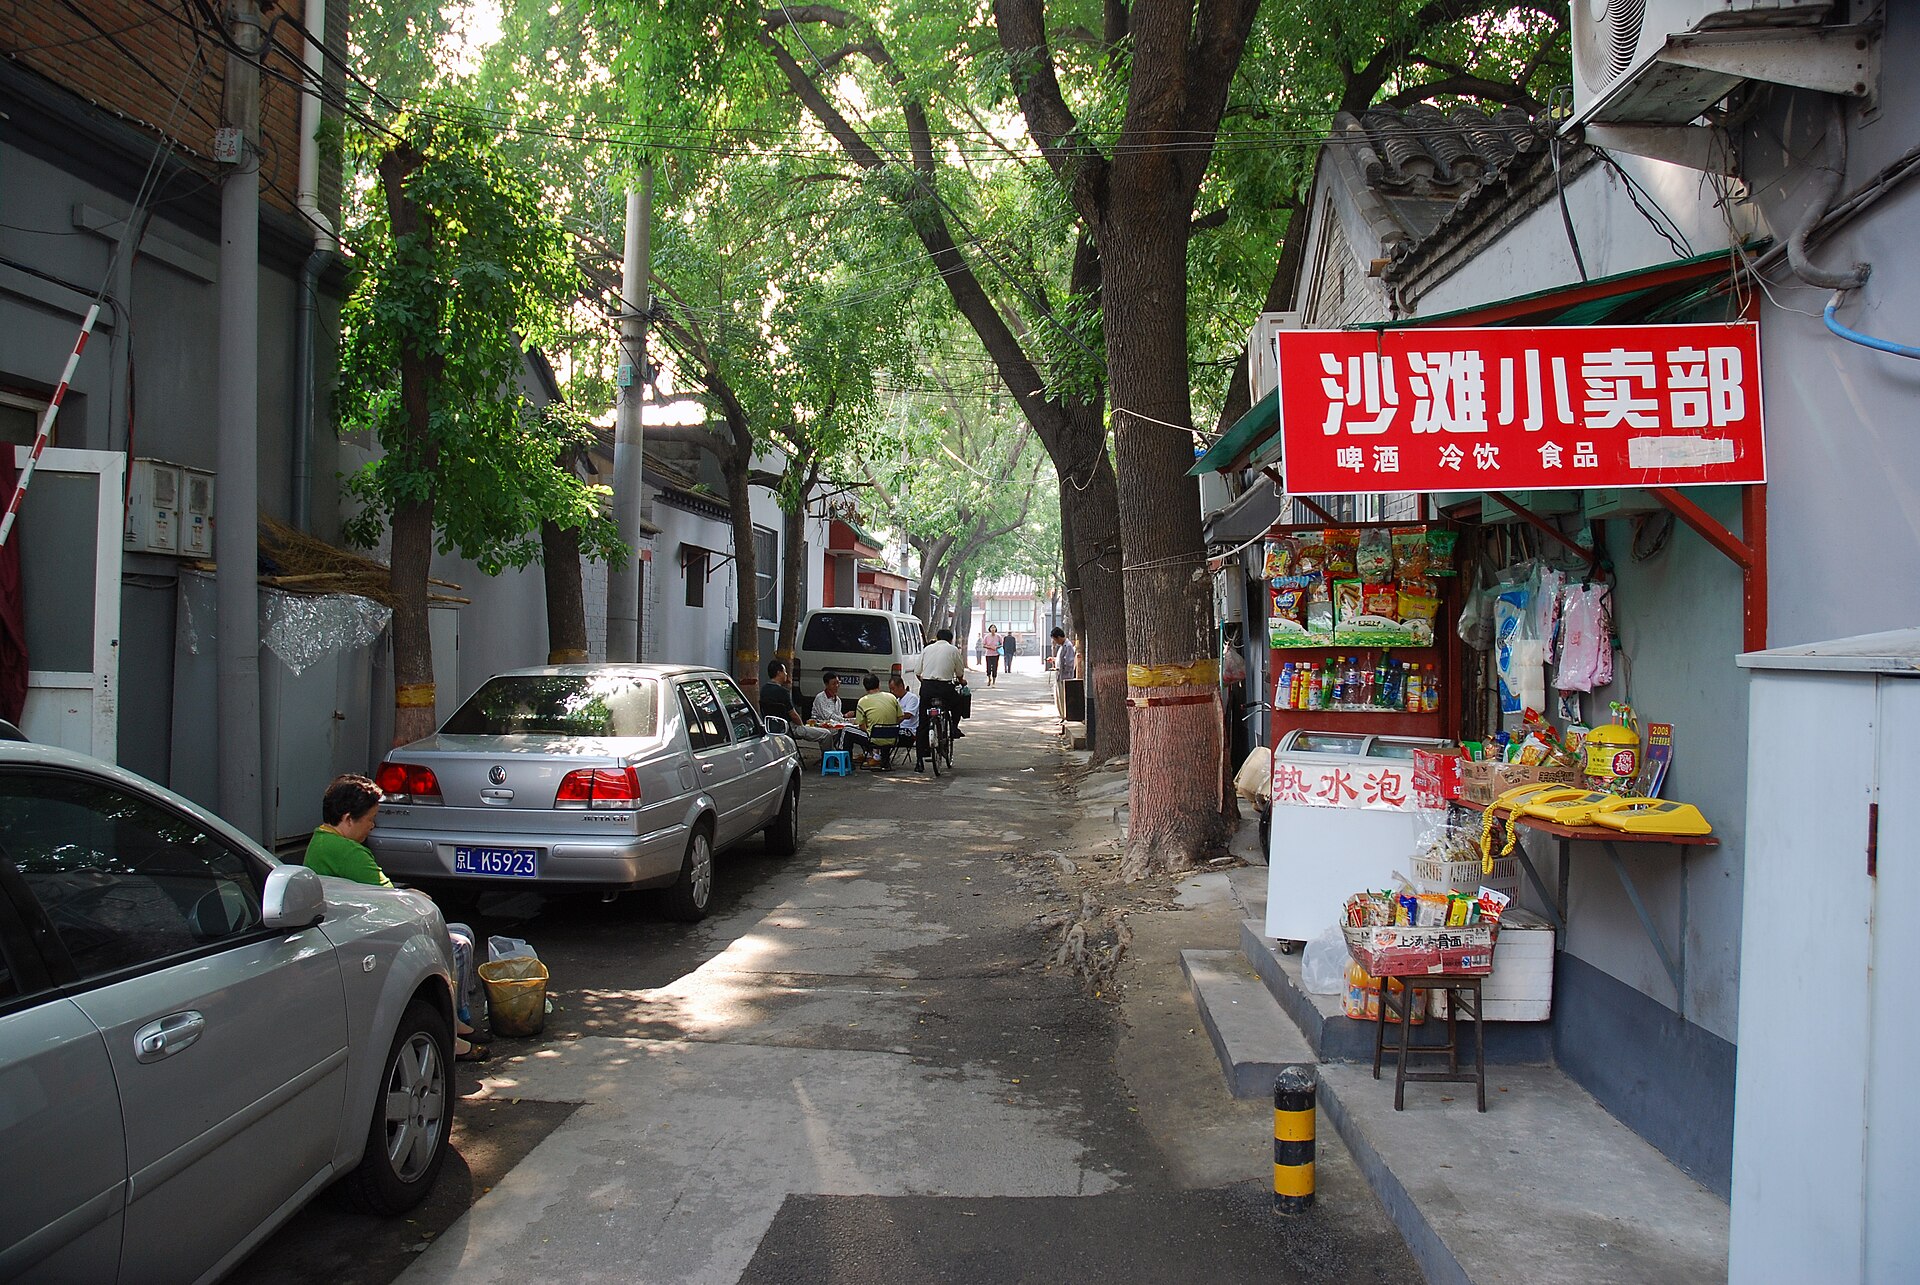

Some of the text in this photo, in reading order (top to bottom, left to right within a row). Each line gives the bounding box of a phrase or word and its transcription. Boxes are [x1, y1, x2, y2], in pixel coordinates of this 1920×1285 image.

[1319, 346, 1745, 436] 沙滩小卖部
[1336, 440, 1599, 474] 啤酒 冷饮 食品
[1273, 764, 1407, 806] 热水泡
[581, 814, 611, 822] JETTA
